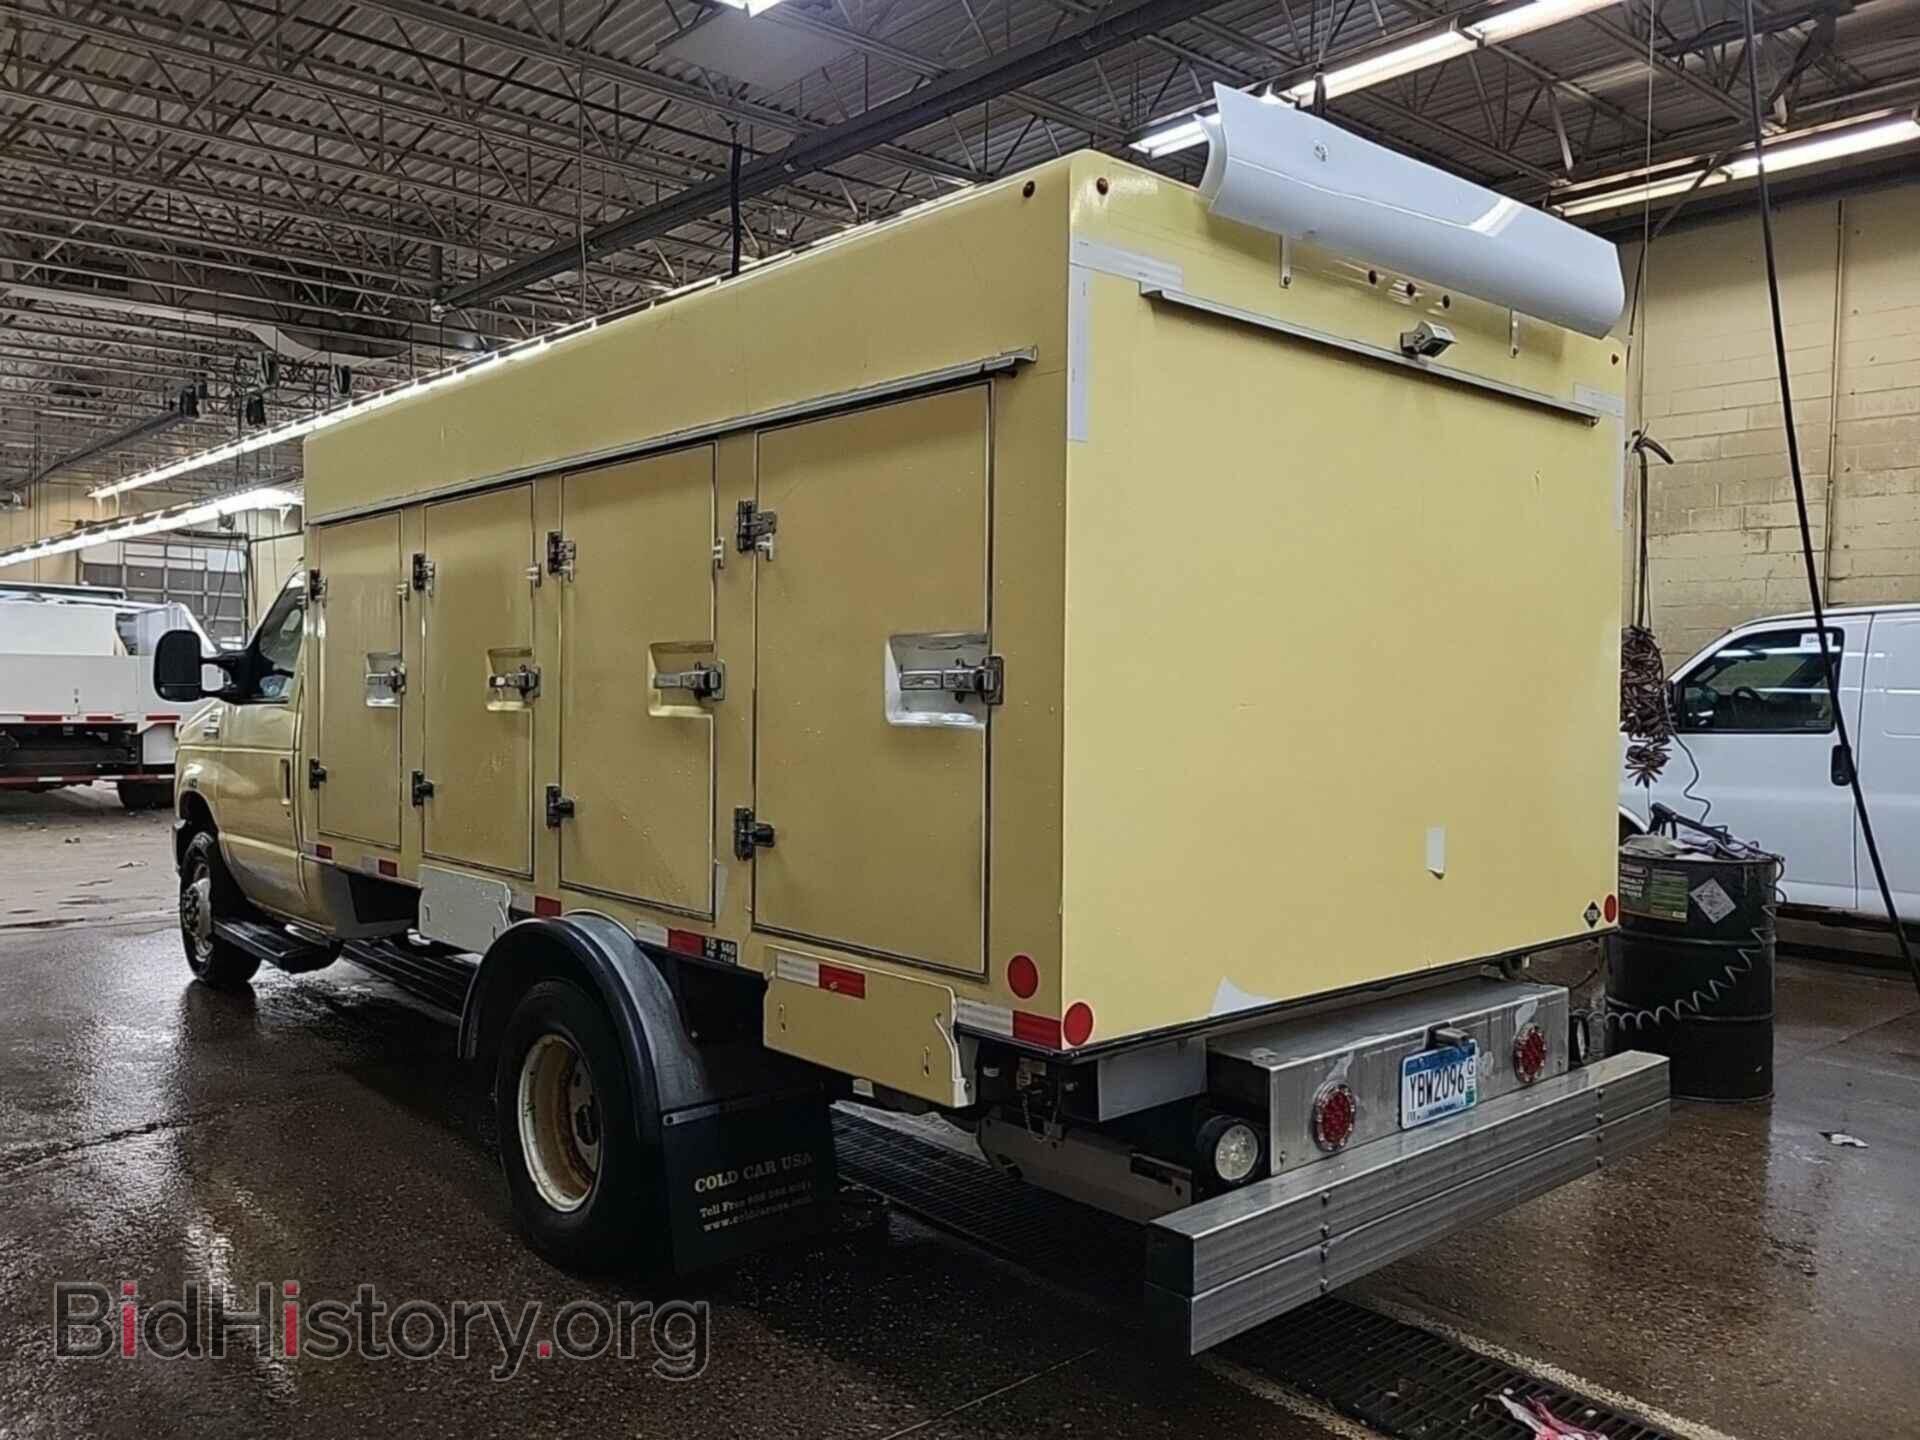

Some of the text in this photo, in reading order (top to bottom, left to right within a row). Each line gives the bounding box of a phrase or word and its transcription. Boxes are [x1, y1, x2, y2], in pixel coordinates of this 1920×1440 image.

[1410, 1063, 1465, 1110] YBW2096
[694, 1170, 738, 1192] COLD
[743, 1160, 777, 1180] CAR
[780, 1152, 813, 1169] USA
